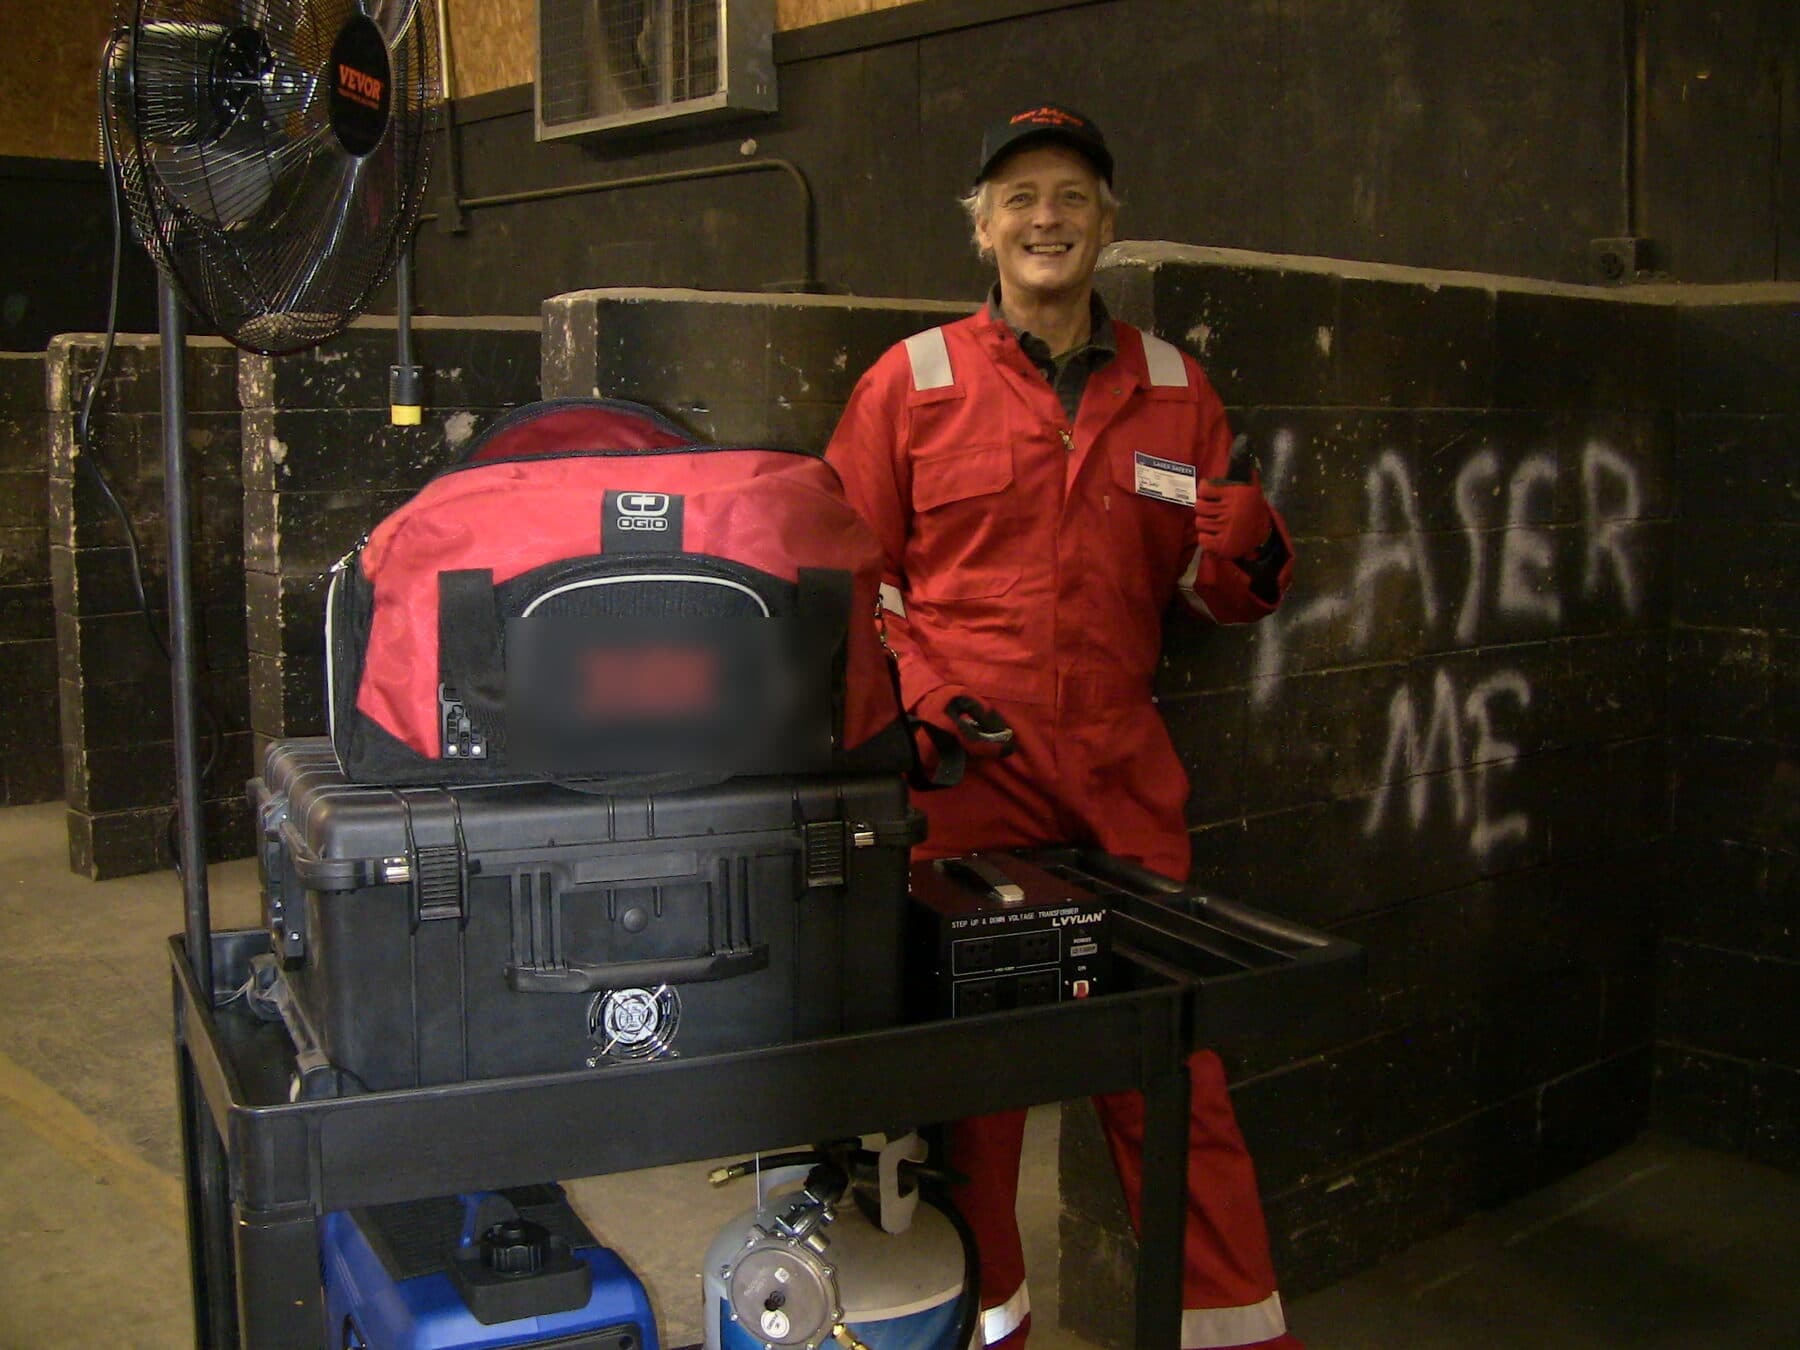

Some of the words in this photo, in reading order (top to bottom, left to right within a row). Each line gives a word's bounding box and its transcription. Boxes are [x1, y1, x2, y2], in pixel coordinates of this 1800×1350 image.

[339, 63, 381, 101] VEVOR
[1172, 464, 1192, 474] SAFETY
[617, 517, 668, 531] OGIO
[1251, 429, 1641, 709] LASER
[1363, 667, 1532, 856] ME
[951, 919, 968, 929] STEP
[970, 918, 980, 927] UP
[989, 915, 1006, 925] DOWN
[1007, 911, 1036, 923] VOLTAGE
[1038, 907, 1079, 919] TRANSFORMER
[1052, 912, 1103, 928] LVYUAN
